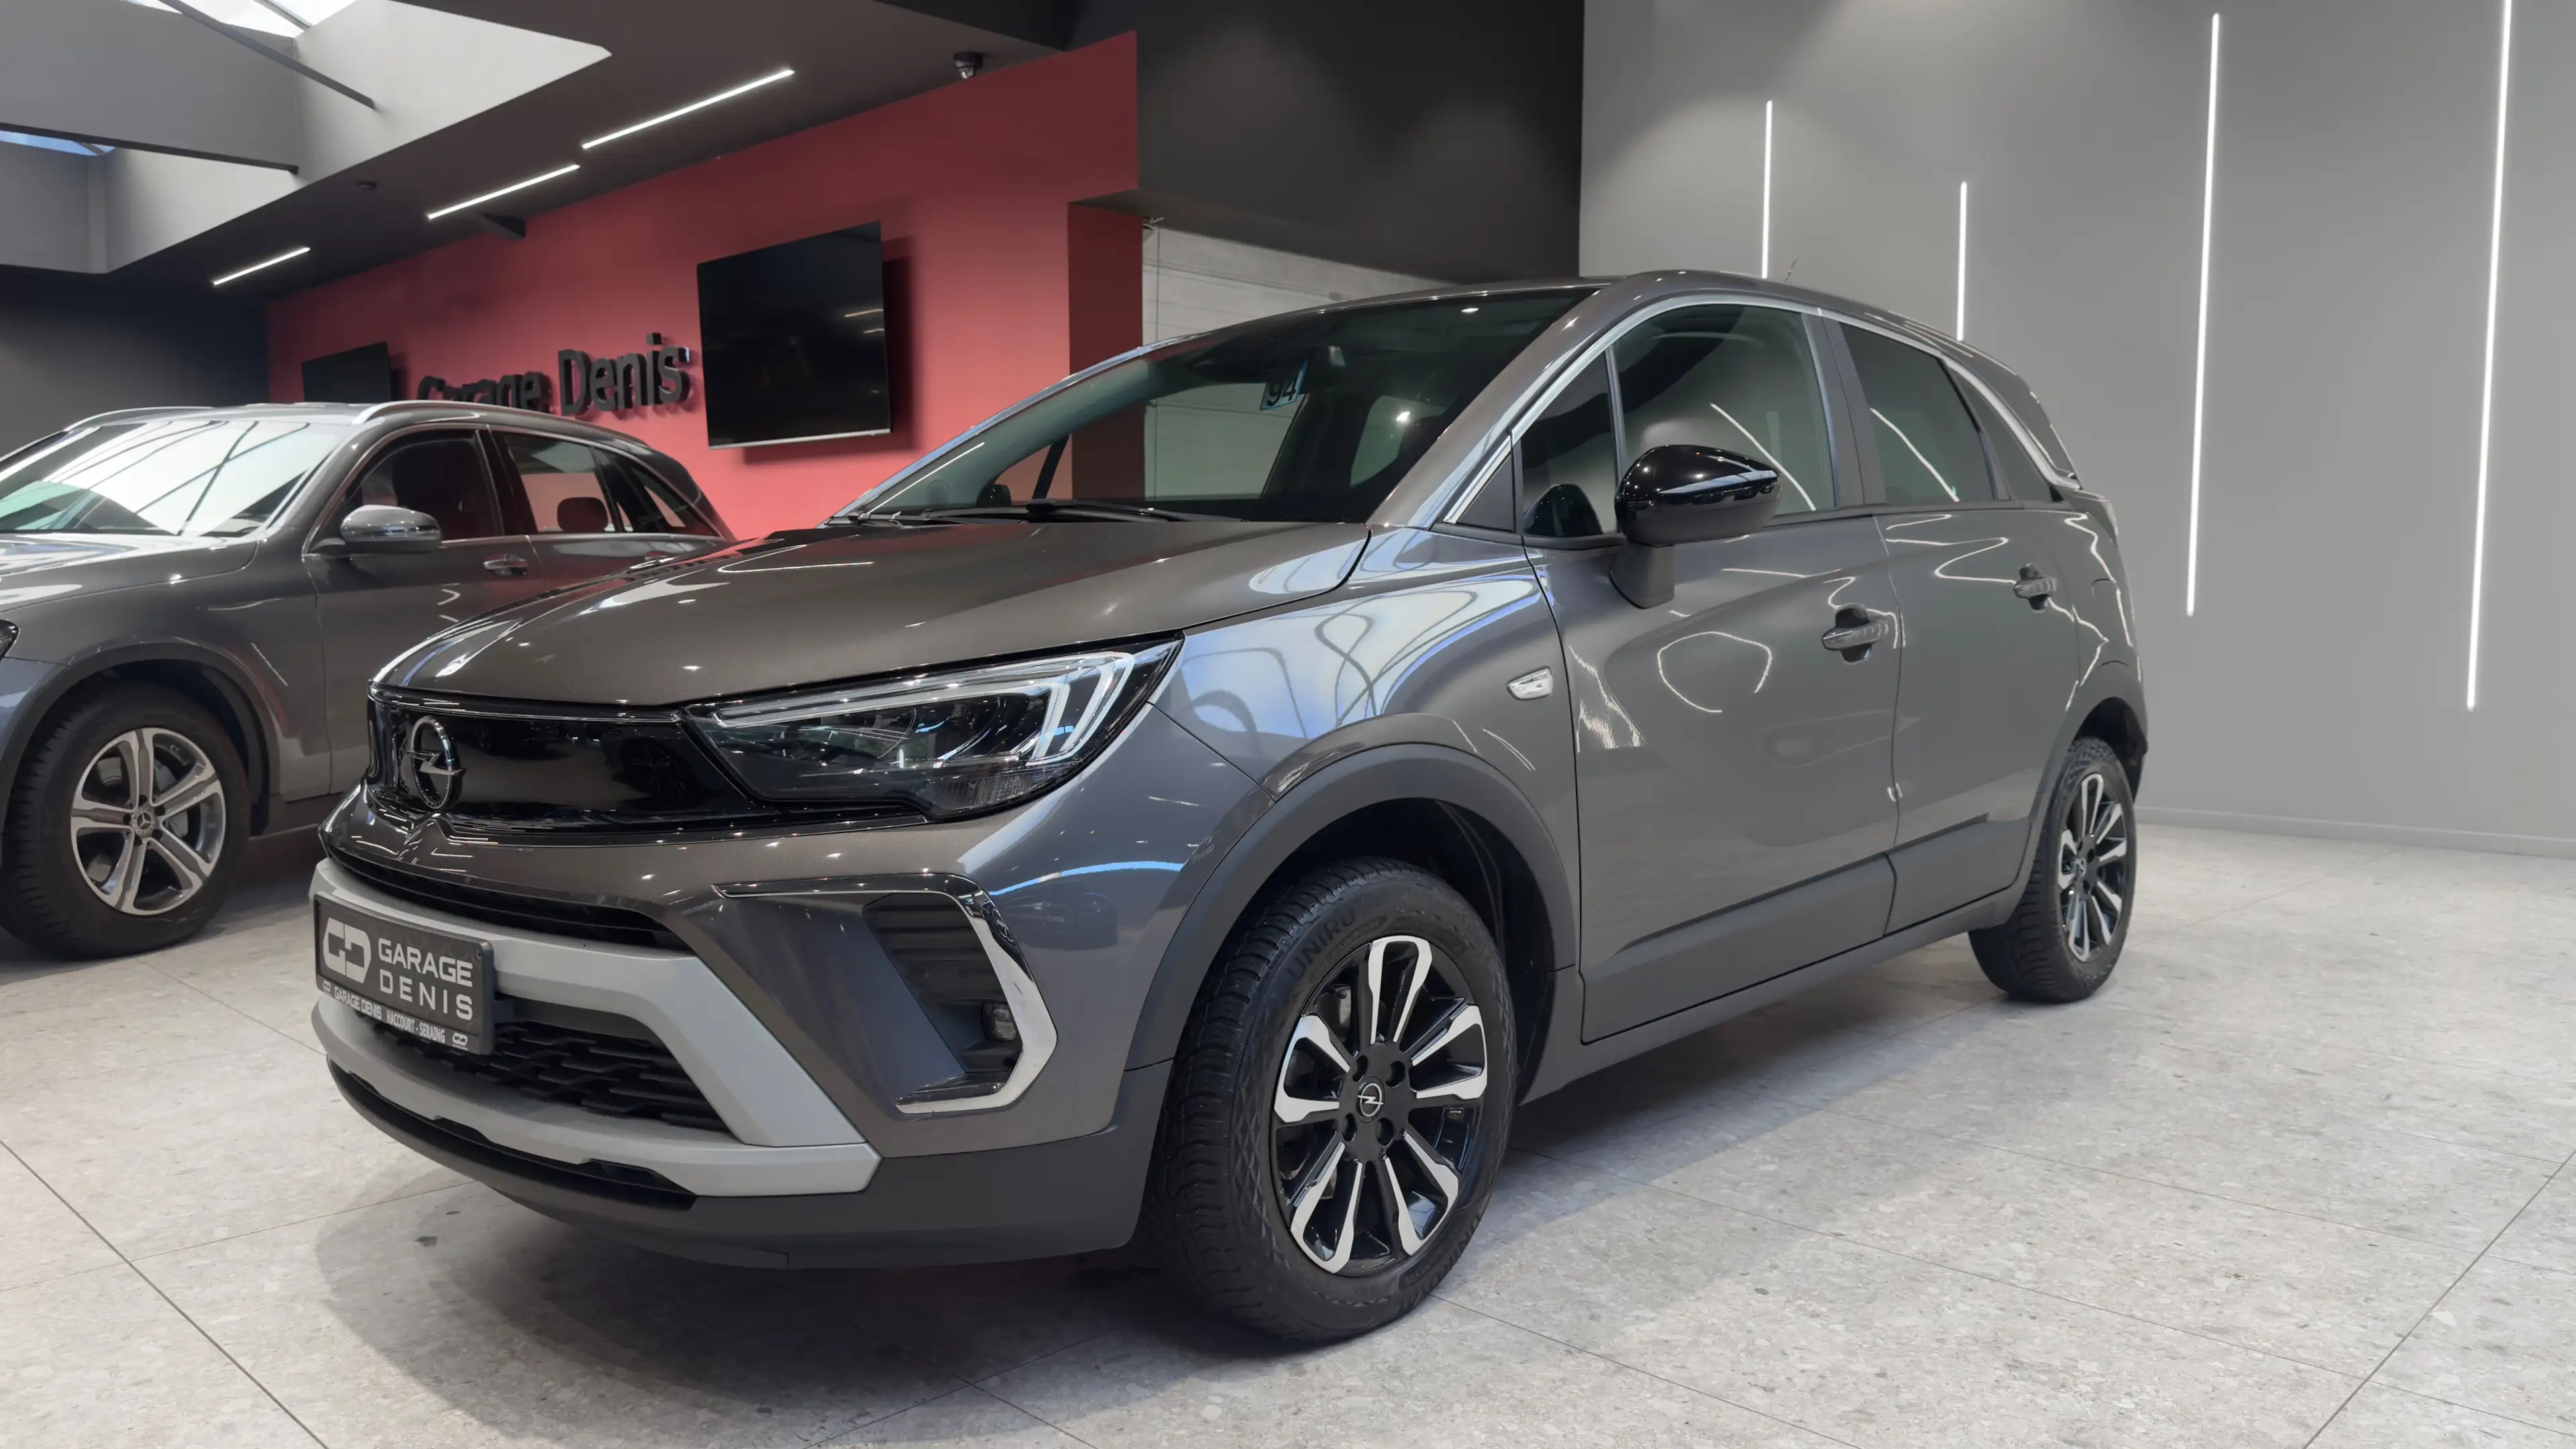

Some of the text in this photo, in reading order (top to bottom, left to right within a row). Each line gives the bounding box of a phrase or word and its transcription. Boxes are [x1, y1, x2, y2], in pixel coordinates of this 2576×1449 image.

[558, 332, 690, 417] Denis
[378, 938, 473, 987] GARAGE
[334, 985, 360, 1010] GARAGE
[361, 998, 382, 1020] DENIS
[386, 1009, 415, 1032] HACCOURT
[419, 1022, 445, 1044] SERAING
[380, 969, 473, 1020] DENIS
